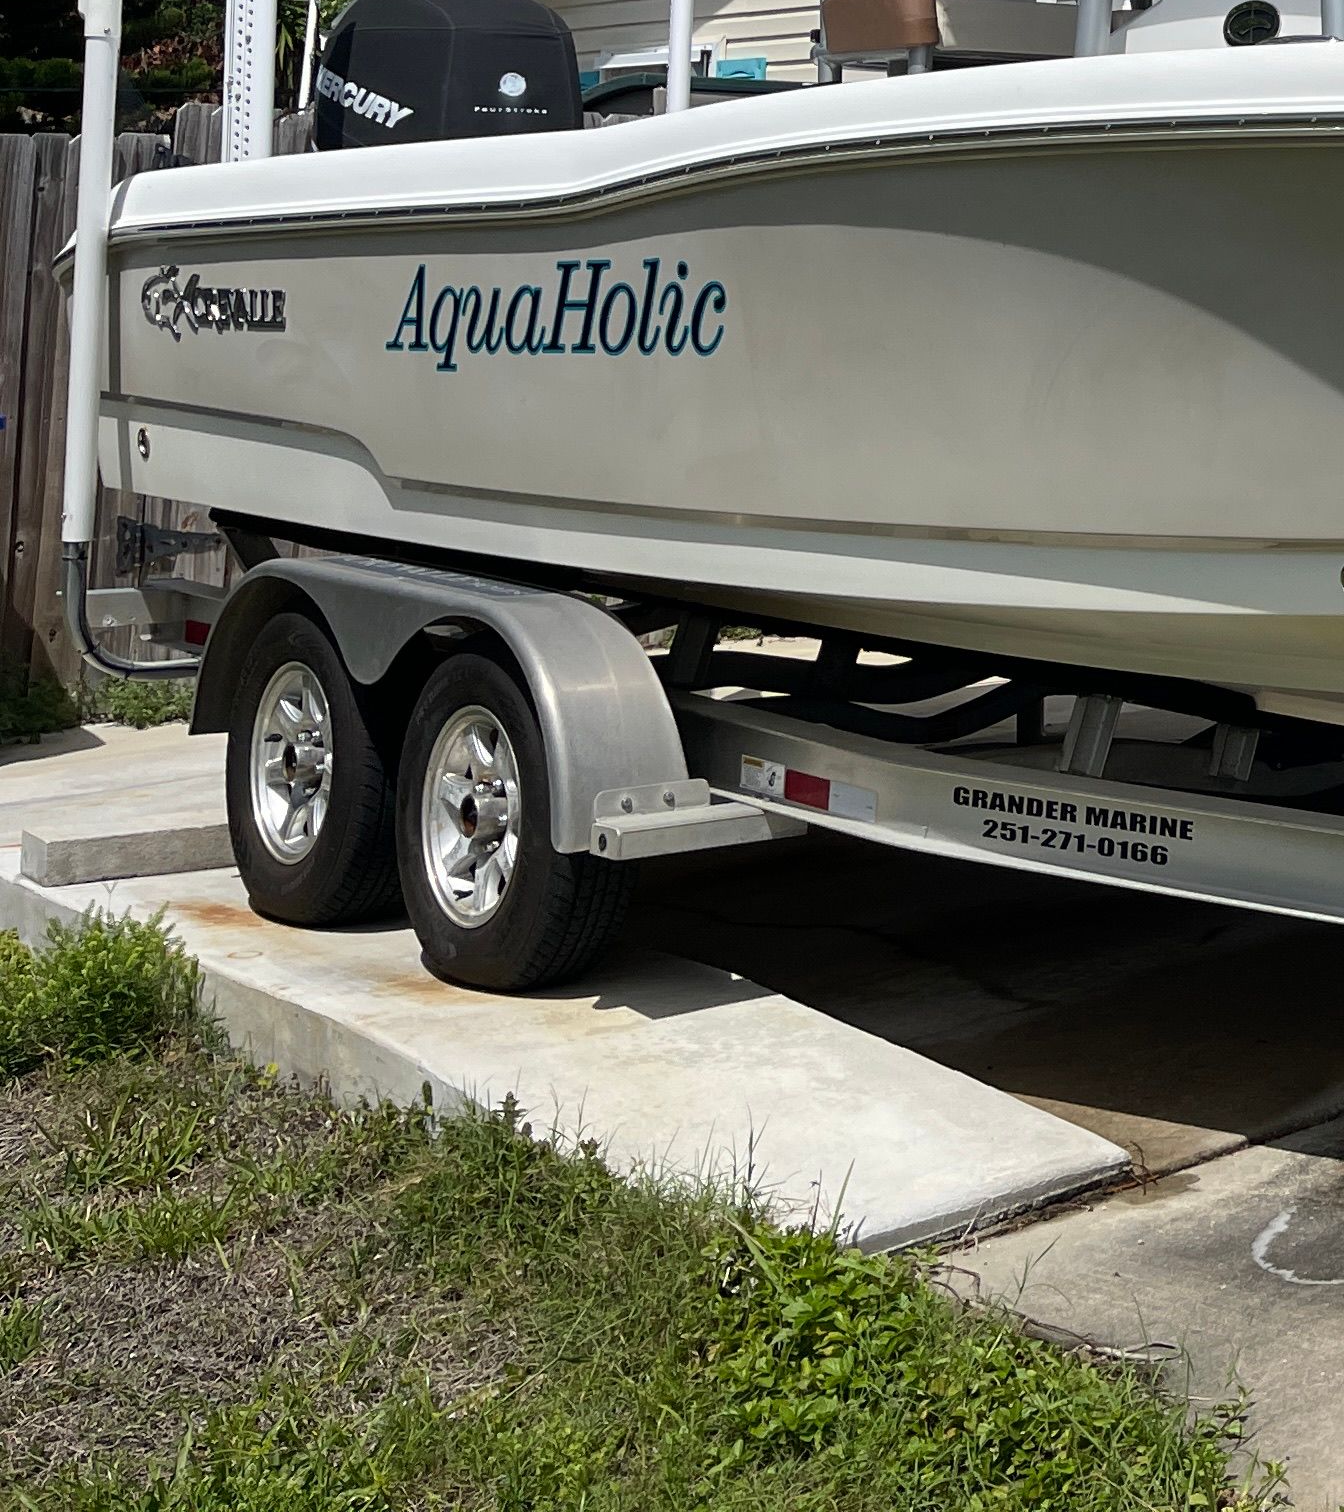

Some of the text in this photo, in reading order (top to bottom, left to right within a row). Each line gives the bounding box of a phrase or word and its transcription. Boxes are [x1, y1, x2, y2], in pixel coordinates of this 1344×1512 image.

[384, 257, 727, 372] AquaHolic
[953, 786, 1194, 841] GRANDER MARINE
[982, 819, 1169, 866] 251-271-0166
